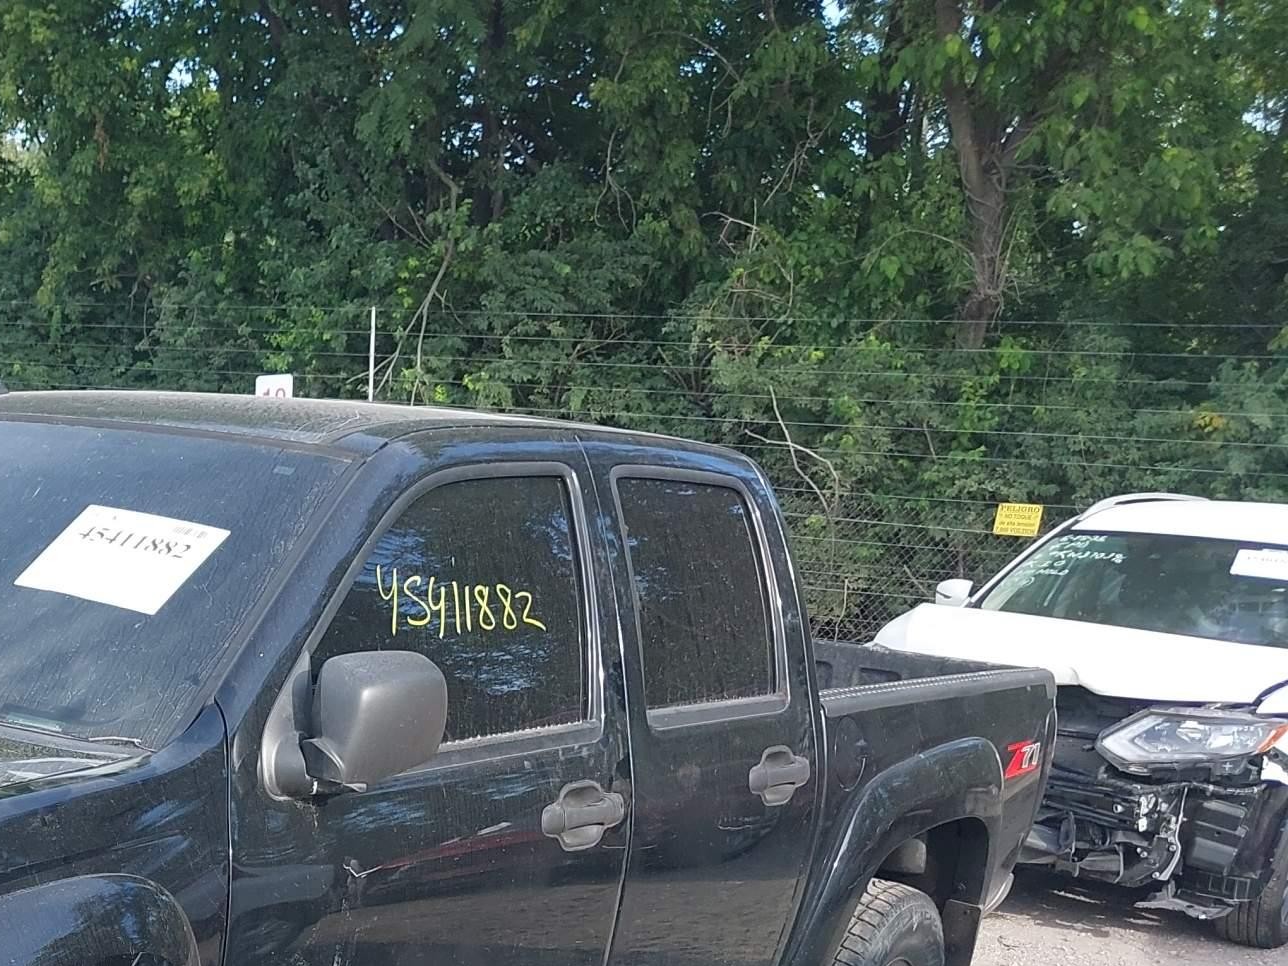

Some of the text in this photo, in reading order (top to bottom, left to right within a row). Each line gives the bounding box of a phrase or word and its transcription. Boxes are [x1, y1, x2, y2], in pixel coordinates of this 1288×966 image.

[79, 526, 191, 559] 45411882
[376, 564, 547, 639] 45411882
[1004, 741, 1041, 779] Z71
